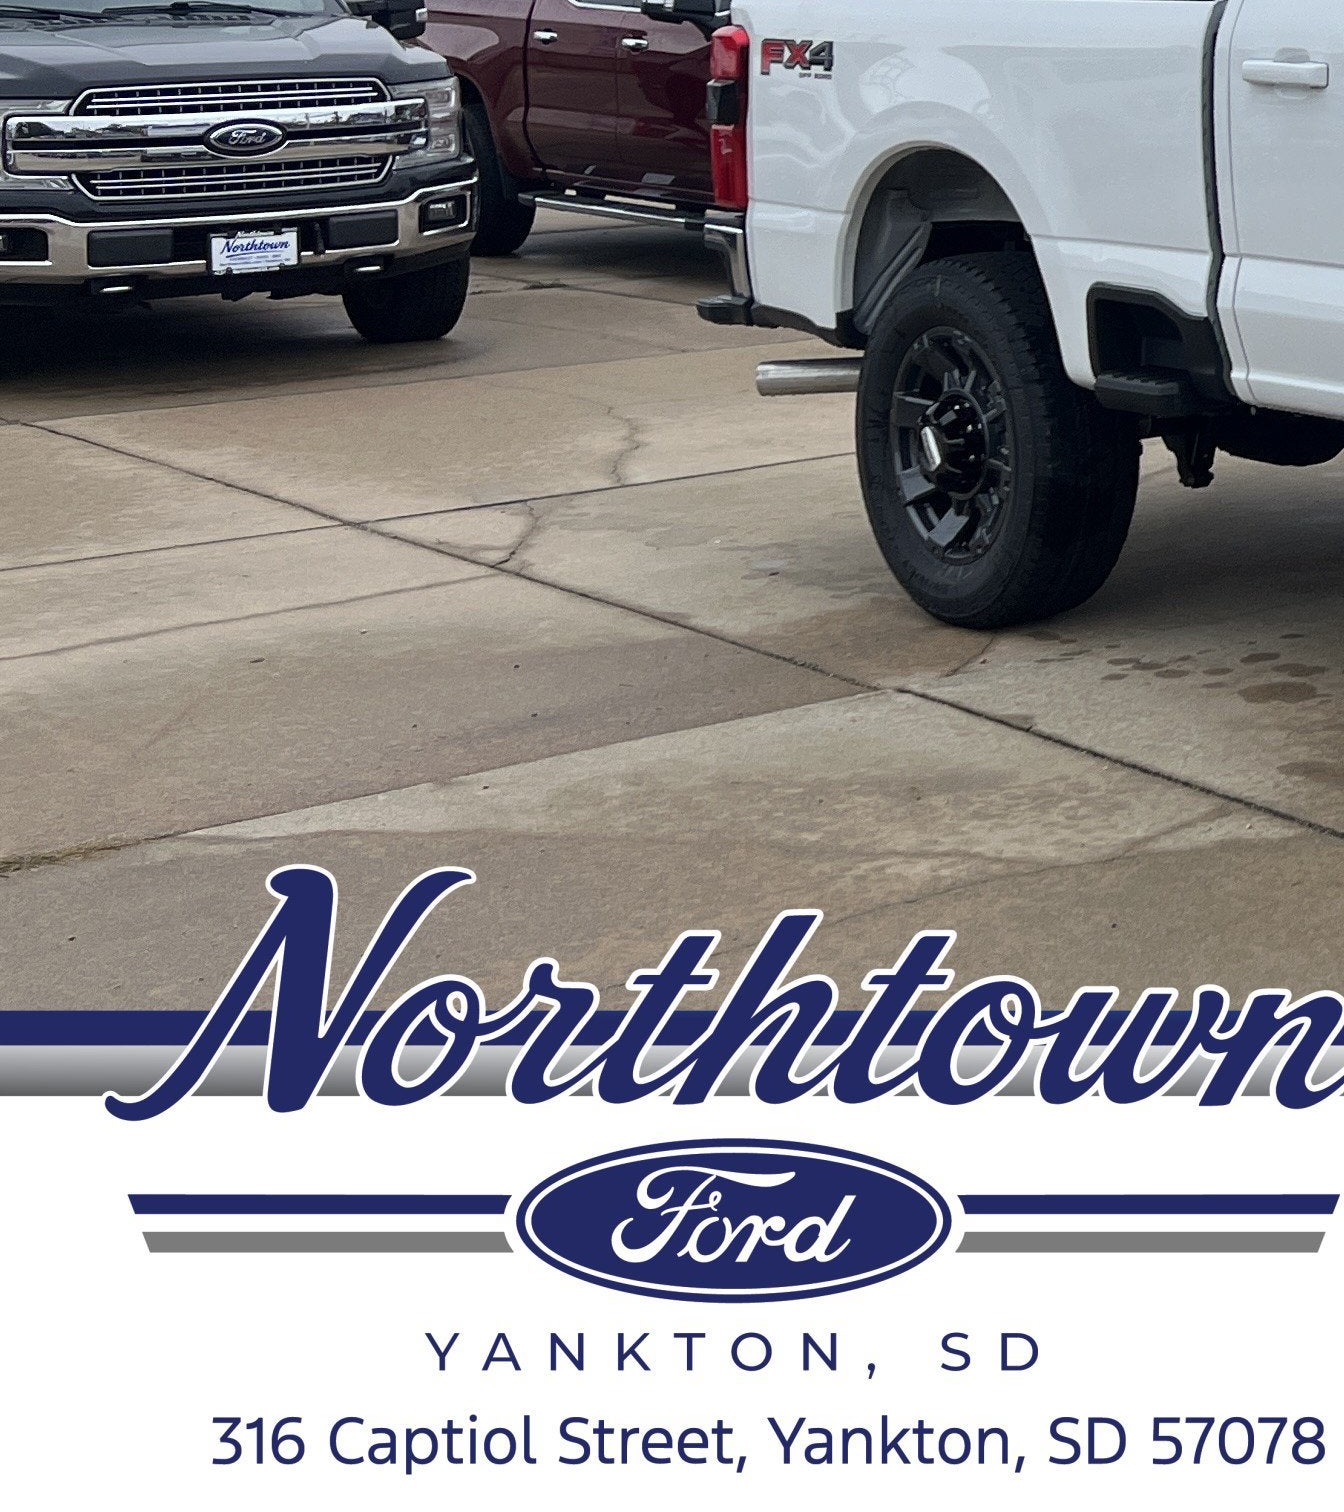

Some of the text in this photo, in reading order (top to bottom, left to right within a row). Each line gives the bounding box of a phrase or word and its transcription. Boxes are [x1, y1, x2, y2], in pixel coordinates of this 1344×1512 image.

[761, 38, 834, 75] FX4
[228, 129, 267, 145] Ford
[220, 238, 291, 255] Northtown
